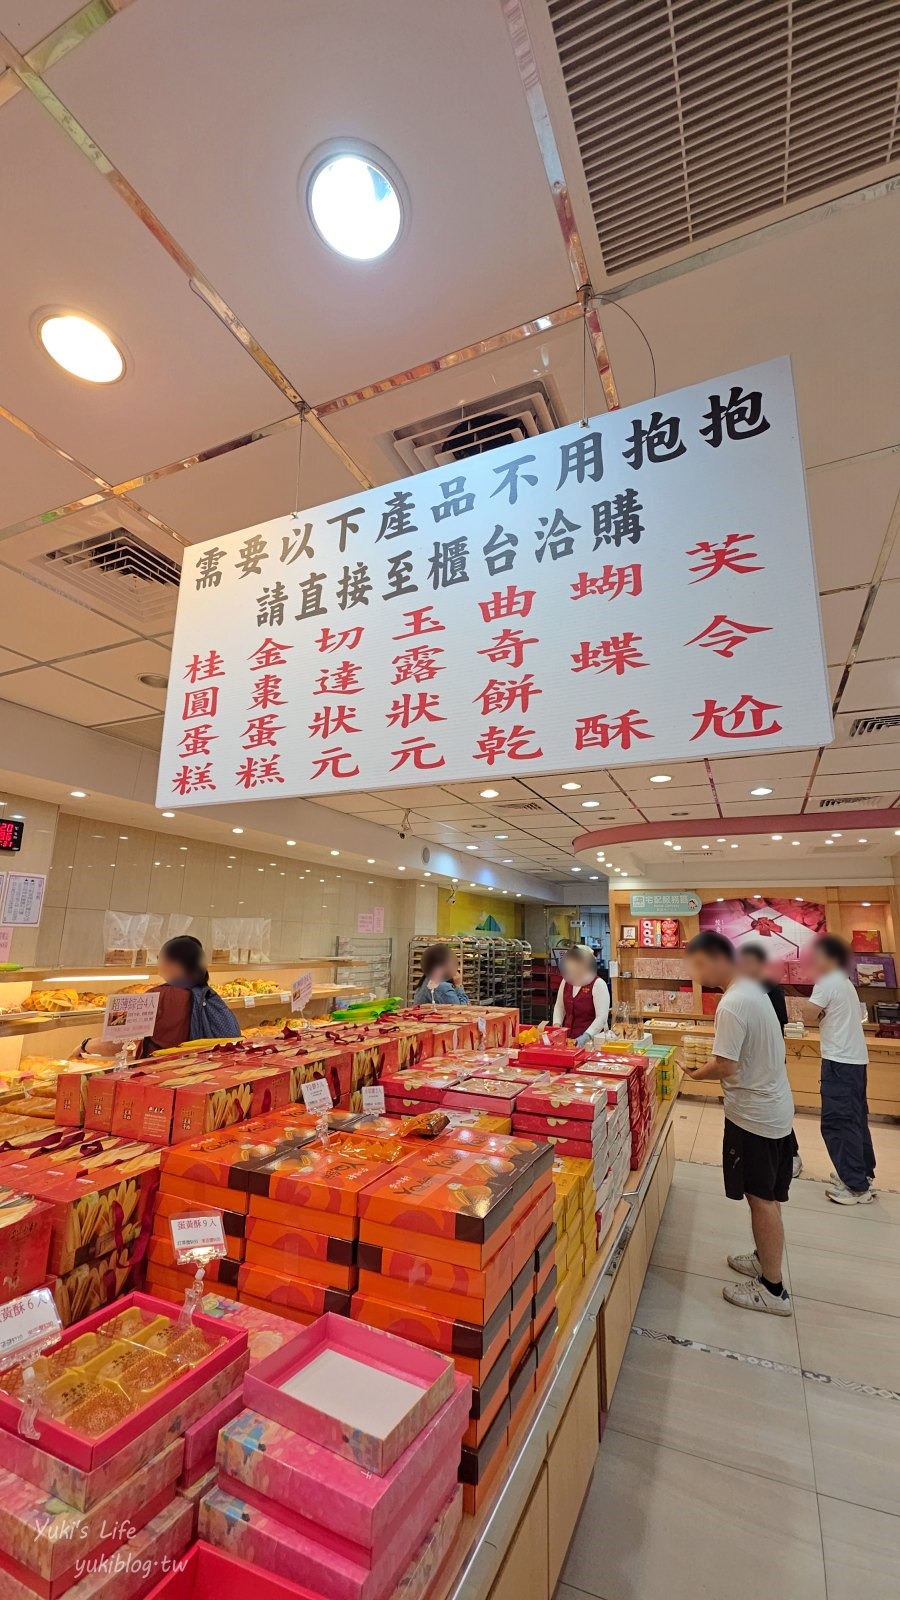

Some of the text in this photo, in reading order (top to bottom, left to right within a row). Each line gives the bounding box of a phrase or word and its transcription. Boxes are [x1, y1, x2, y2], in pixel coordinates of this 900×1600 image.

[195, 386, 771, 591] 需要以下產品不用抱抱
[256, 488, 646, 628] 請直接至櫃台洽購
[235, 637, 294, 789] 金棗蛋糕
[308, 626, 365, 779] 切達狀元
[385, 605, 448, 773] 玉露狀元
[471, 585, 543, 766] 曲奇餅乾
[569, 563, 655, 751] 蝴蝶酥
[684, 533, 783, 743] 芙令尬
[171, 650, 226, 796] 桂圓蛋糕
